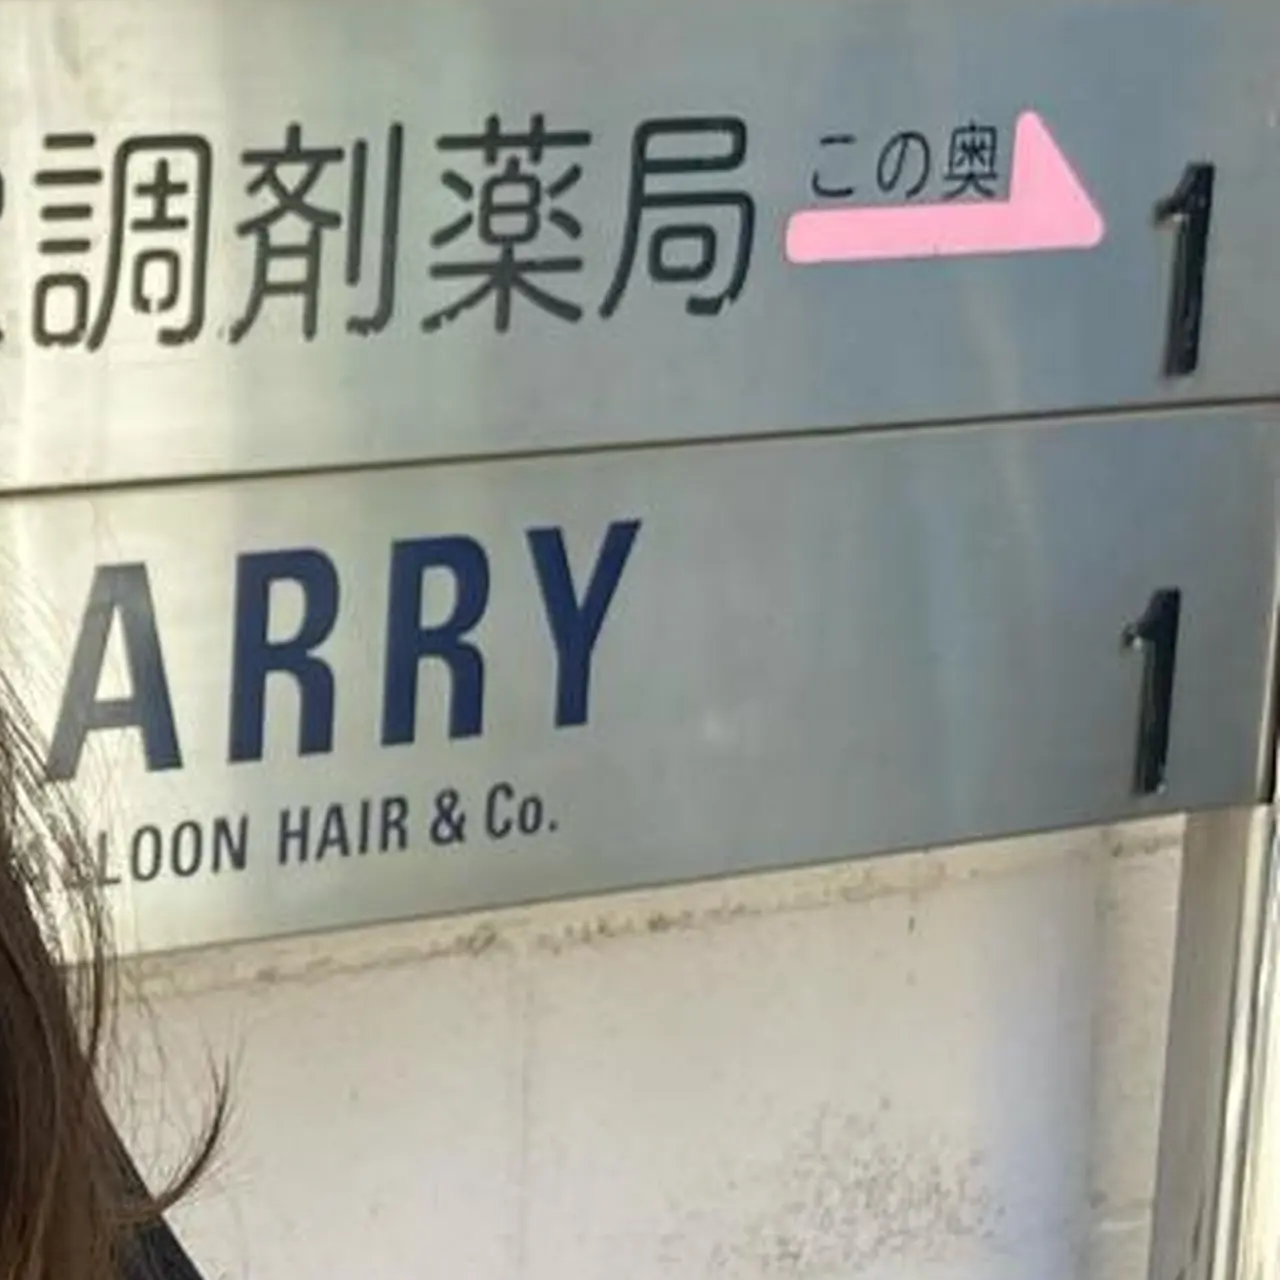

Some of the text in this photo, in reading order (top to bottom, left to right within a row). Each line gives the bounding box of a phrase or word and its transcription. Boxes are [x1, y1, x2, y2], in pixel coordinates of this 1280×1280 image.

[810, 121, 1000, 200] この奥
[1153, 161, 1216, 379] 1
[42, 518, 643, 783] ARRY
[1120, 586, 1182, 797] 1
[278, 795, 409, 867] HAIR
[430, 787, 467, 847] &
[485, 780, 559, 840] Co.
